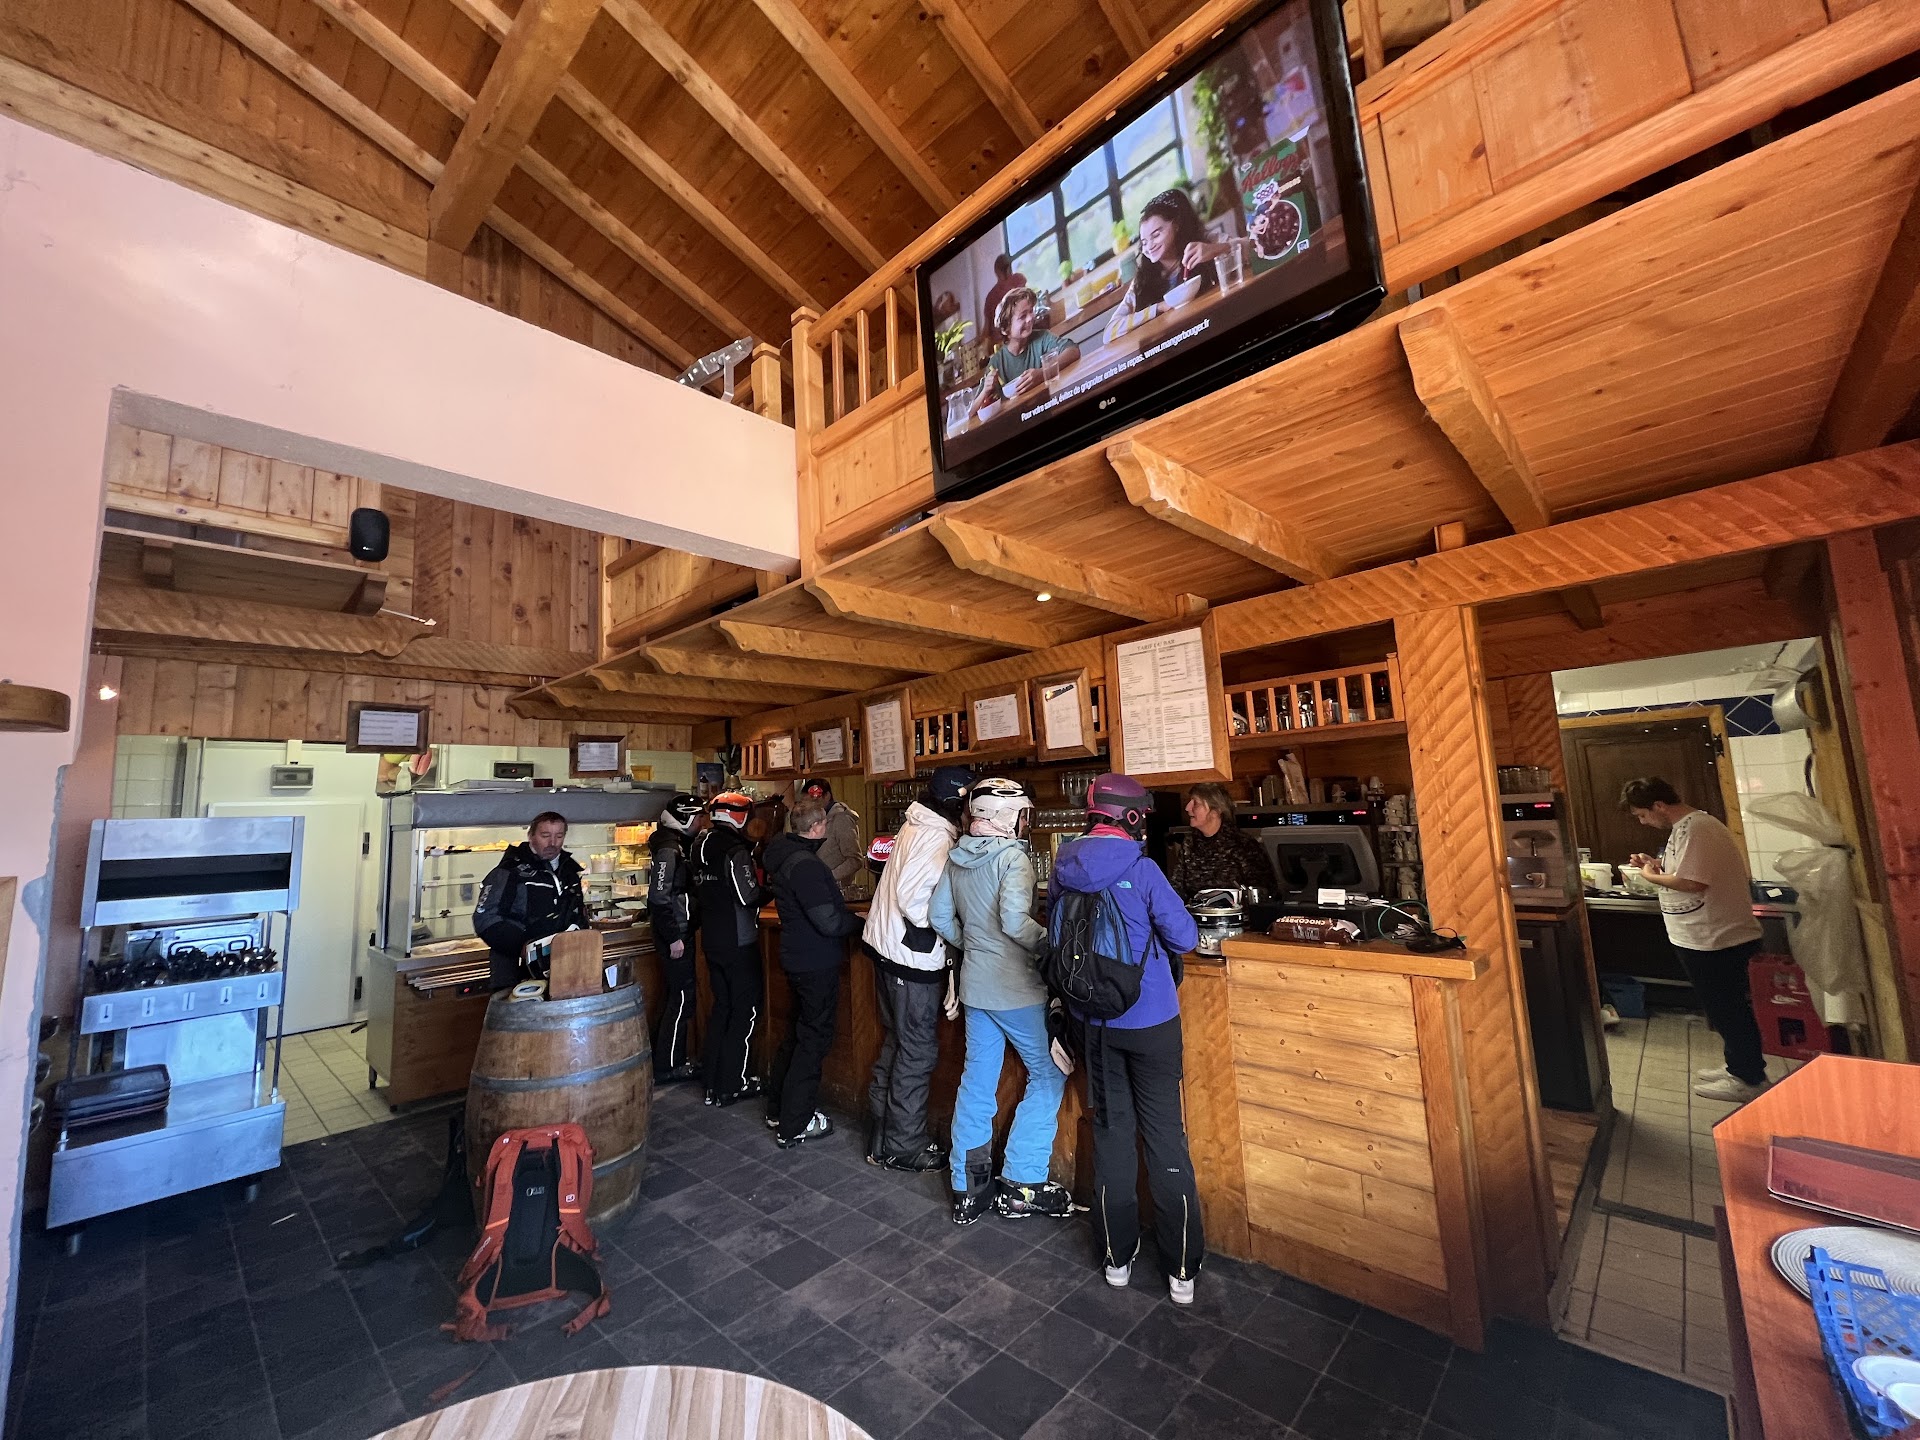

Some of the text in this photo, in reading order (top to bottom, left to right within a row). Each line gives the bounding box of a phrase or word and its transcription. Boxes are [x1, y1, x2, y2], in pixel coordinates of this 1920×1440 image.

[1021, 410, 1032, 422] Pour
[1032, 404, 1045, 416] votre
[1073, 385, 1081, 395] de
[1081, 374, 1104, 393] grignoter
[1103, 366, 1118, 379] entre
[1117, 362, 1127, 372] les
[1144, 318, 1210, 359] www.mangerbouger.fr
